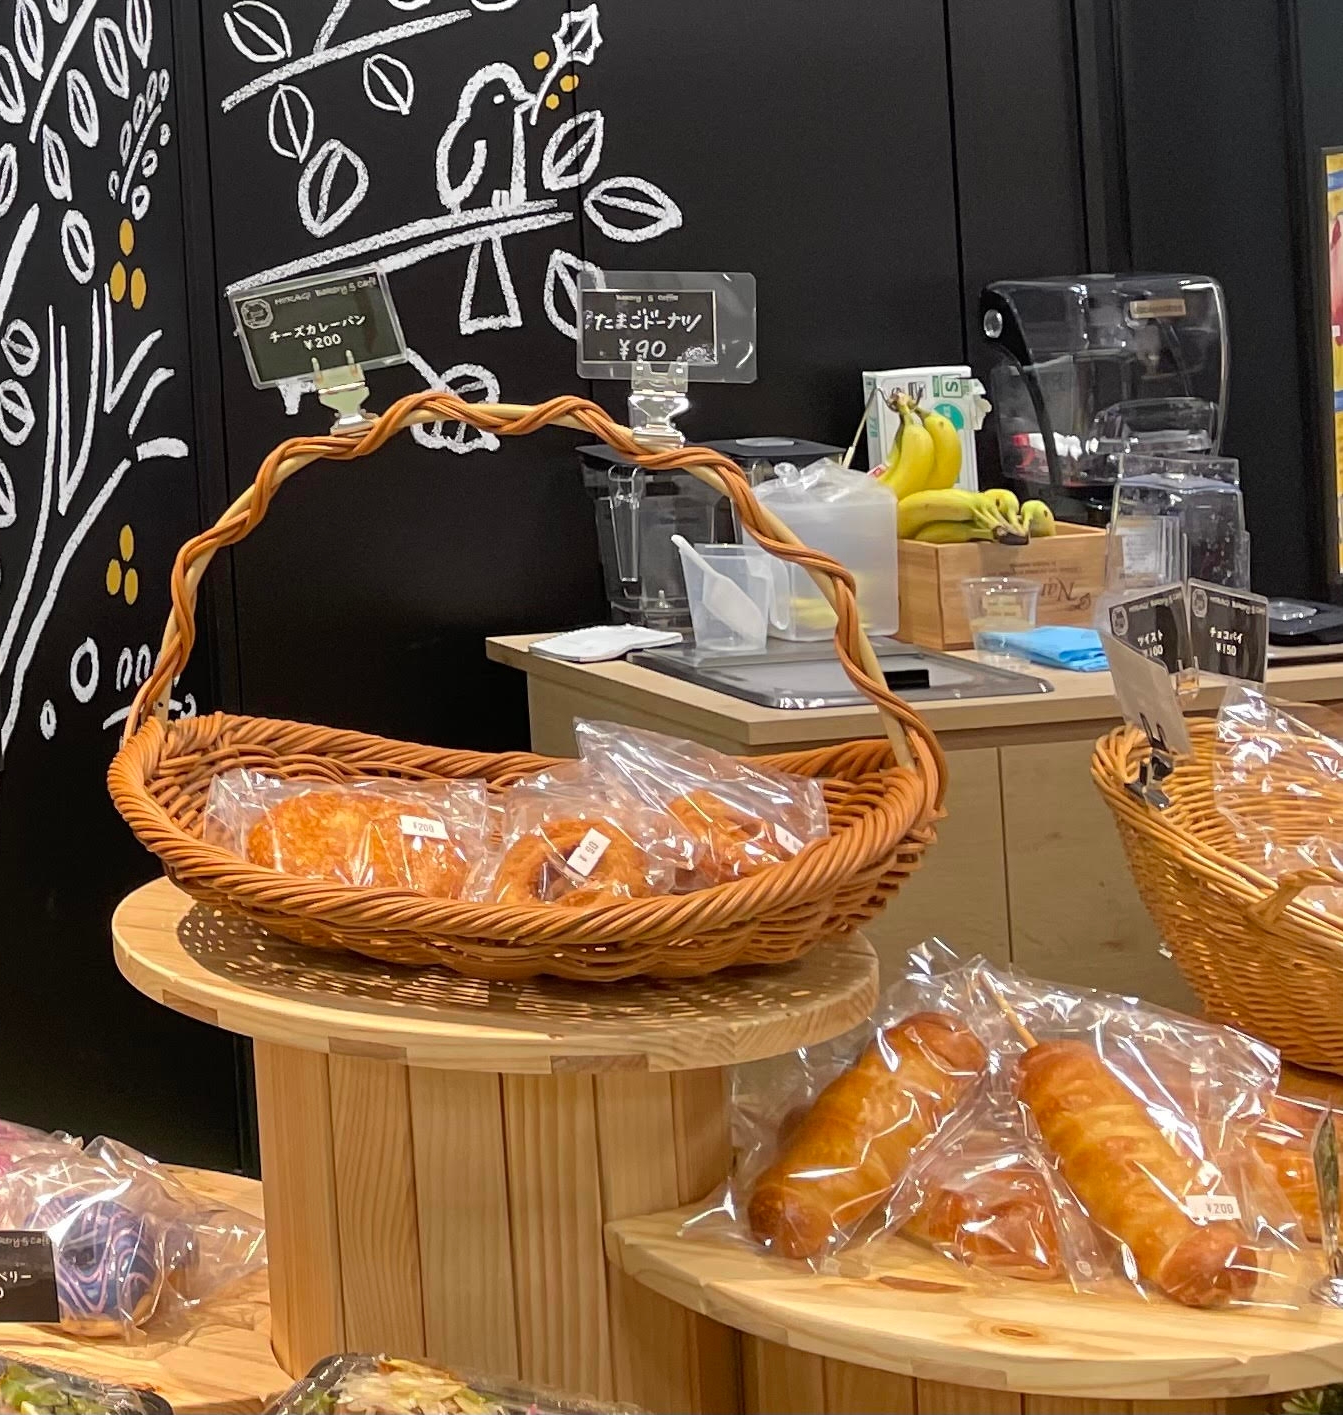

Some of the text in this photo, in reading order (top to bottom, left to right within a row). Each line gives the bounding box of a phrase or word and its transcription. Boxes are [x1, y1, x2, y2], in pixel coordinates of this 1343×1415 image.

[594, 308, 702, 332] たまごドーナツ
[303, 333, 342, 350] ¥200
[618, 338, 667, 360] ¥90
